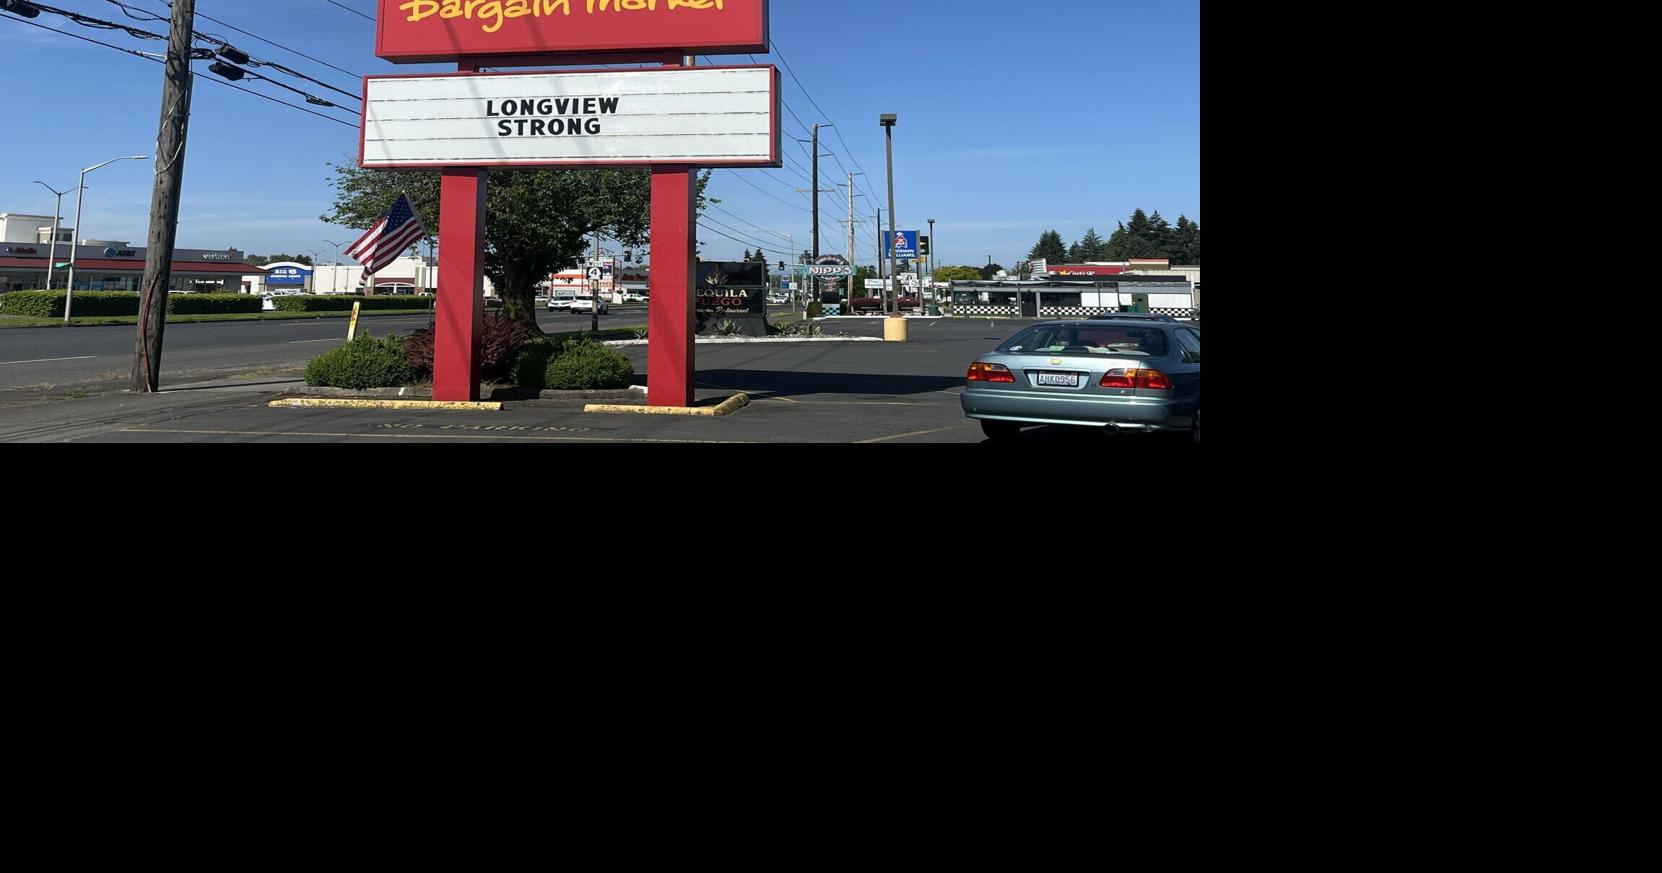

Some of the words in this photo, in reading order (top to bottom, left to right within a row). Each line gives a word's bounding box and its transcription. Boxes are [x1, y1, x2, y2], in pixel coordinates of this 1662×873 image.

[486, 97, 619, 117] LONGVIEW
[498, 117, 601, 137] STRONG
[696, 289, 748, 298] EQUILA
